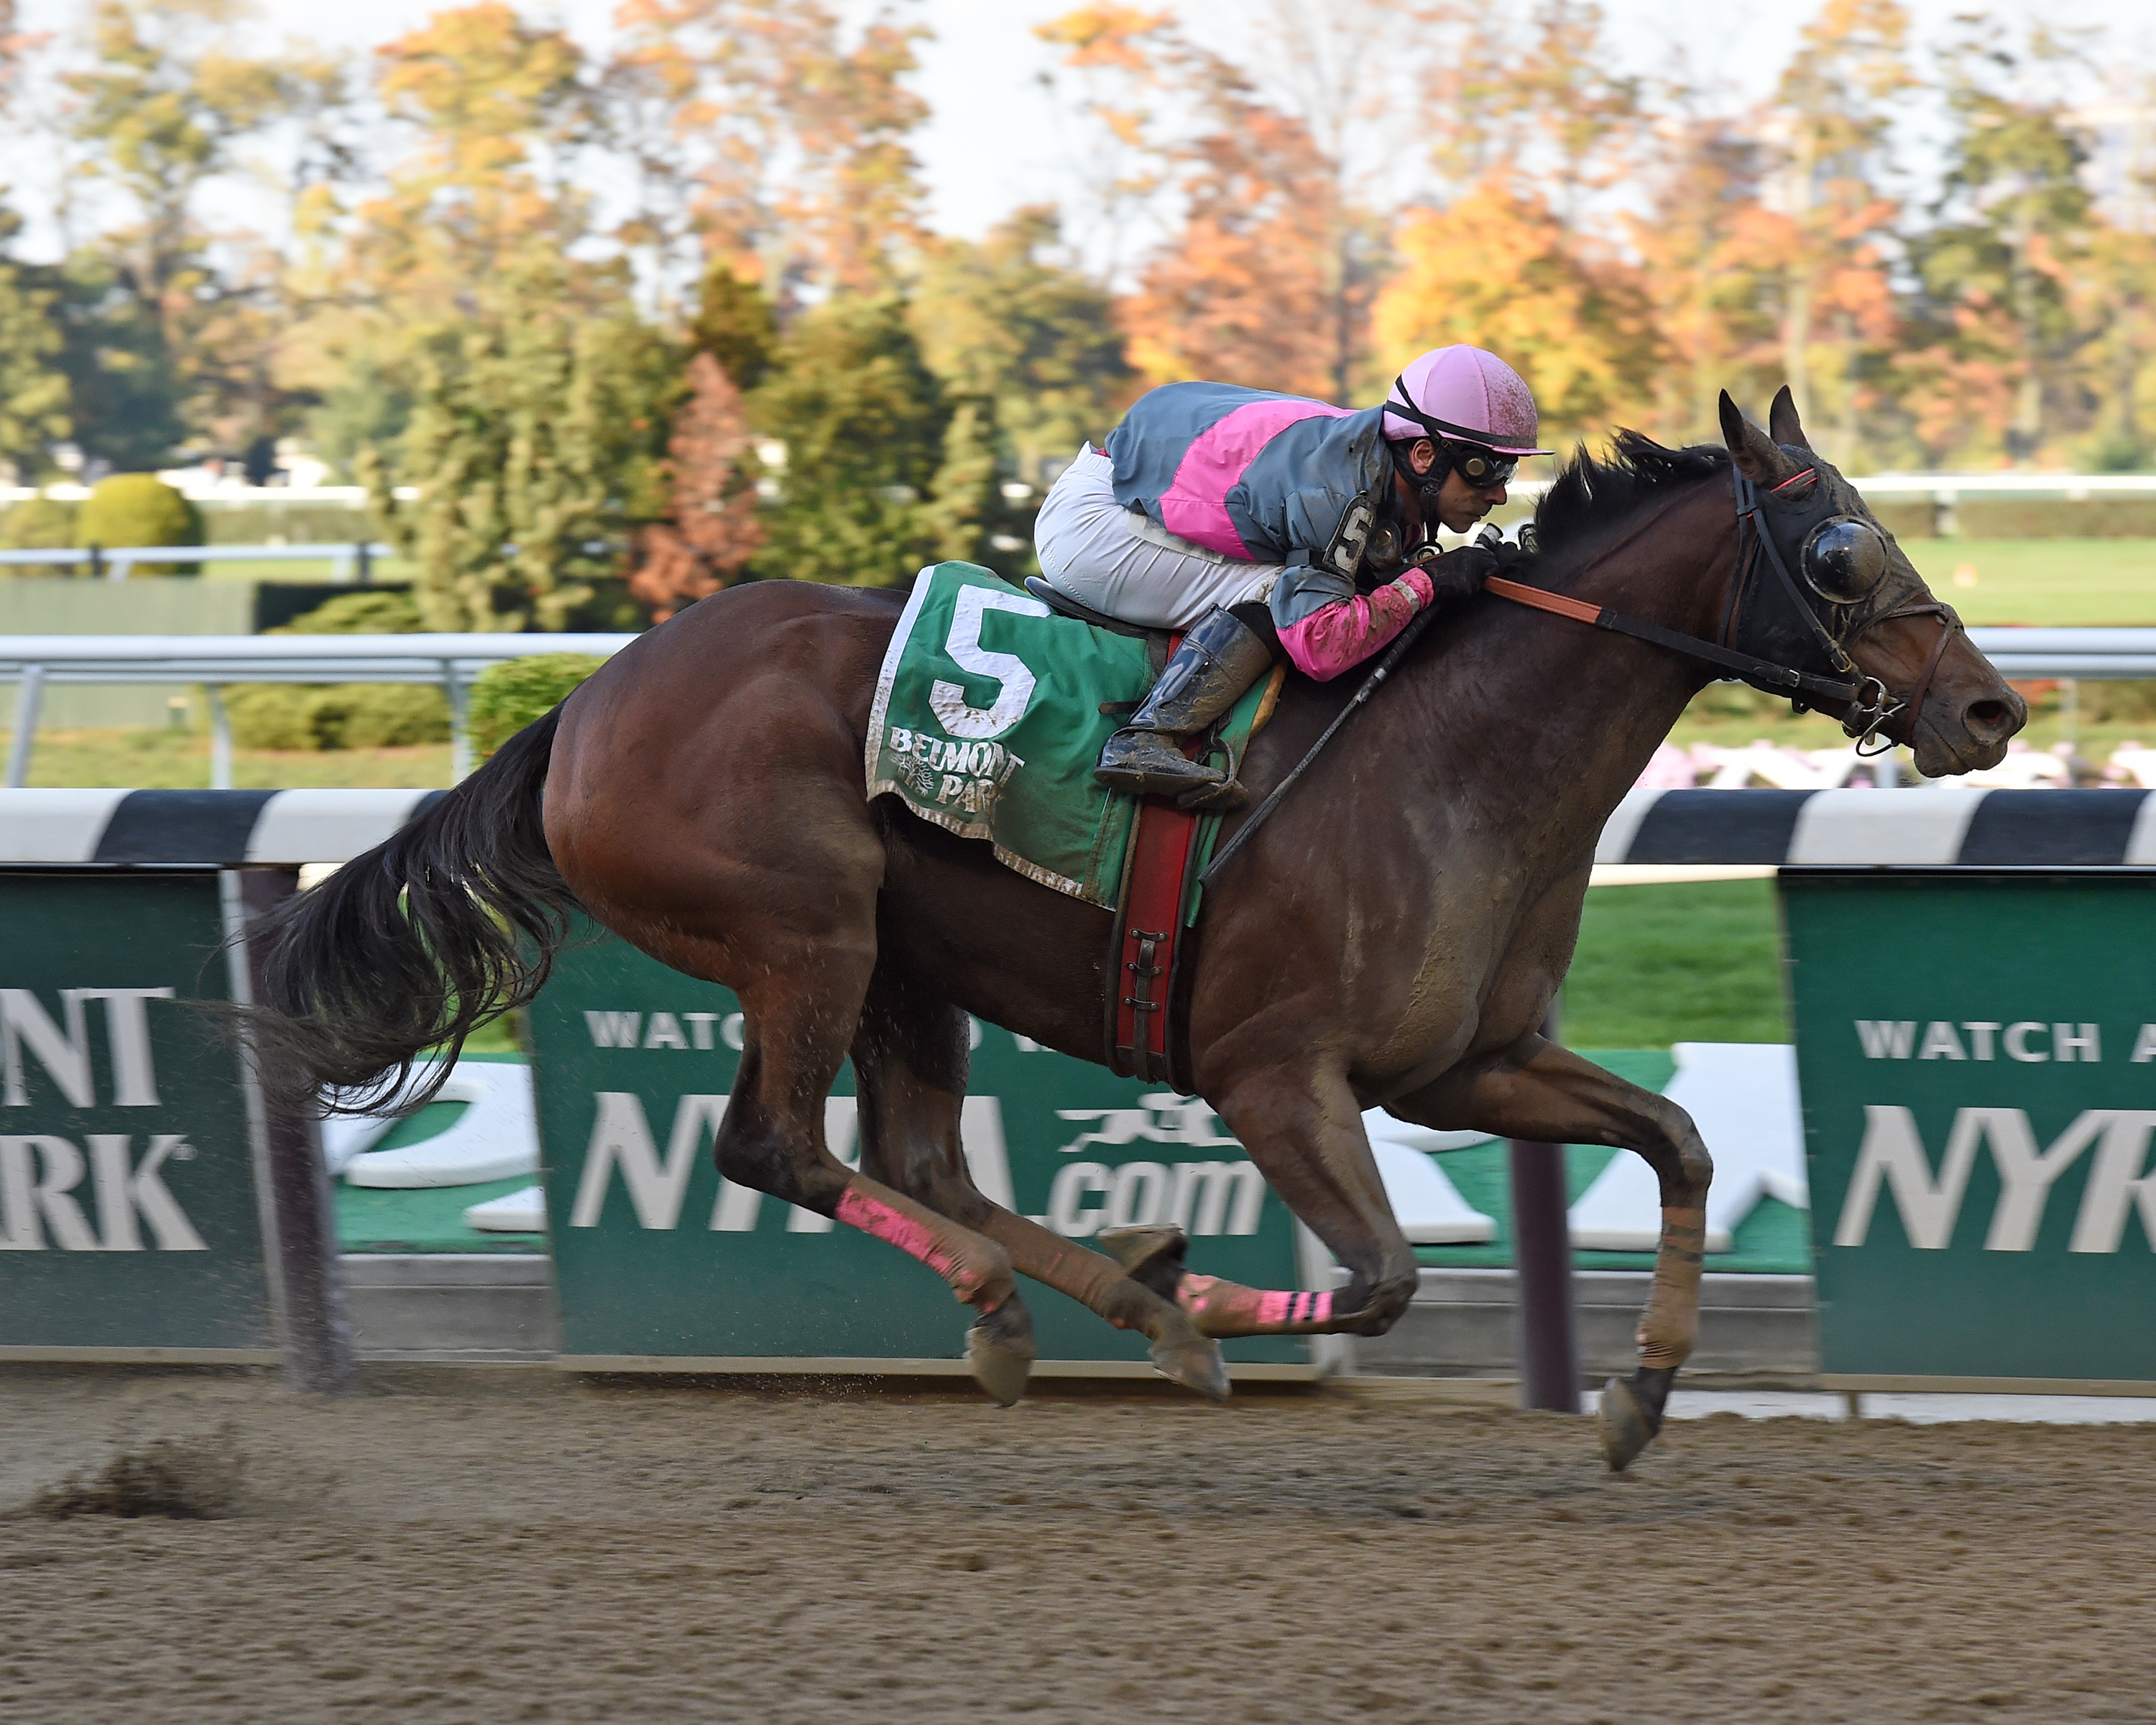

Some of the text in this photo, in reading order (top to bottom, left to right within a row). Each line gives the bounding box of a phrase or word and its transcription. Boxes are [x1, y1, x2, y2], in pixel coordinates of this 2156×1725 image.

[1334, 505, 1374, 574] 5
[929, 584, 1051, 739] 5
[935, 774, 1005, 824] PAR
[0, 988, 175, 1108] NT
[583, 1011, 745, 1051] WATC
[1853, 1020, 2101, 1063] WATCH
[0, 1134, 211, 1251] RK
